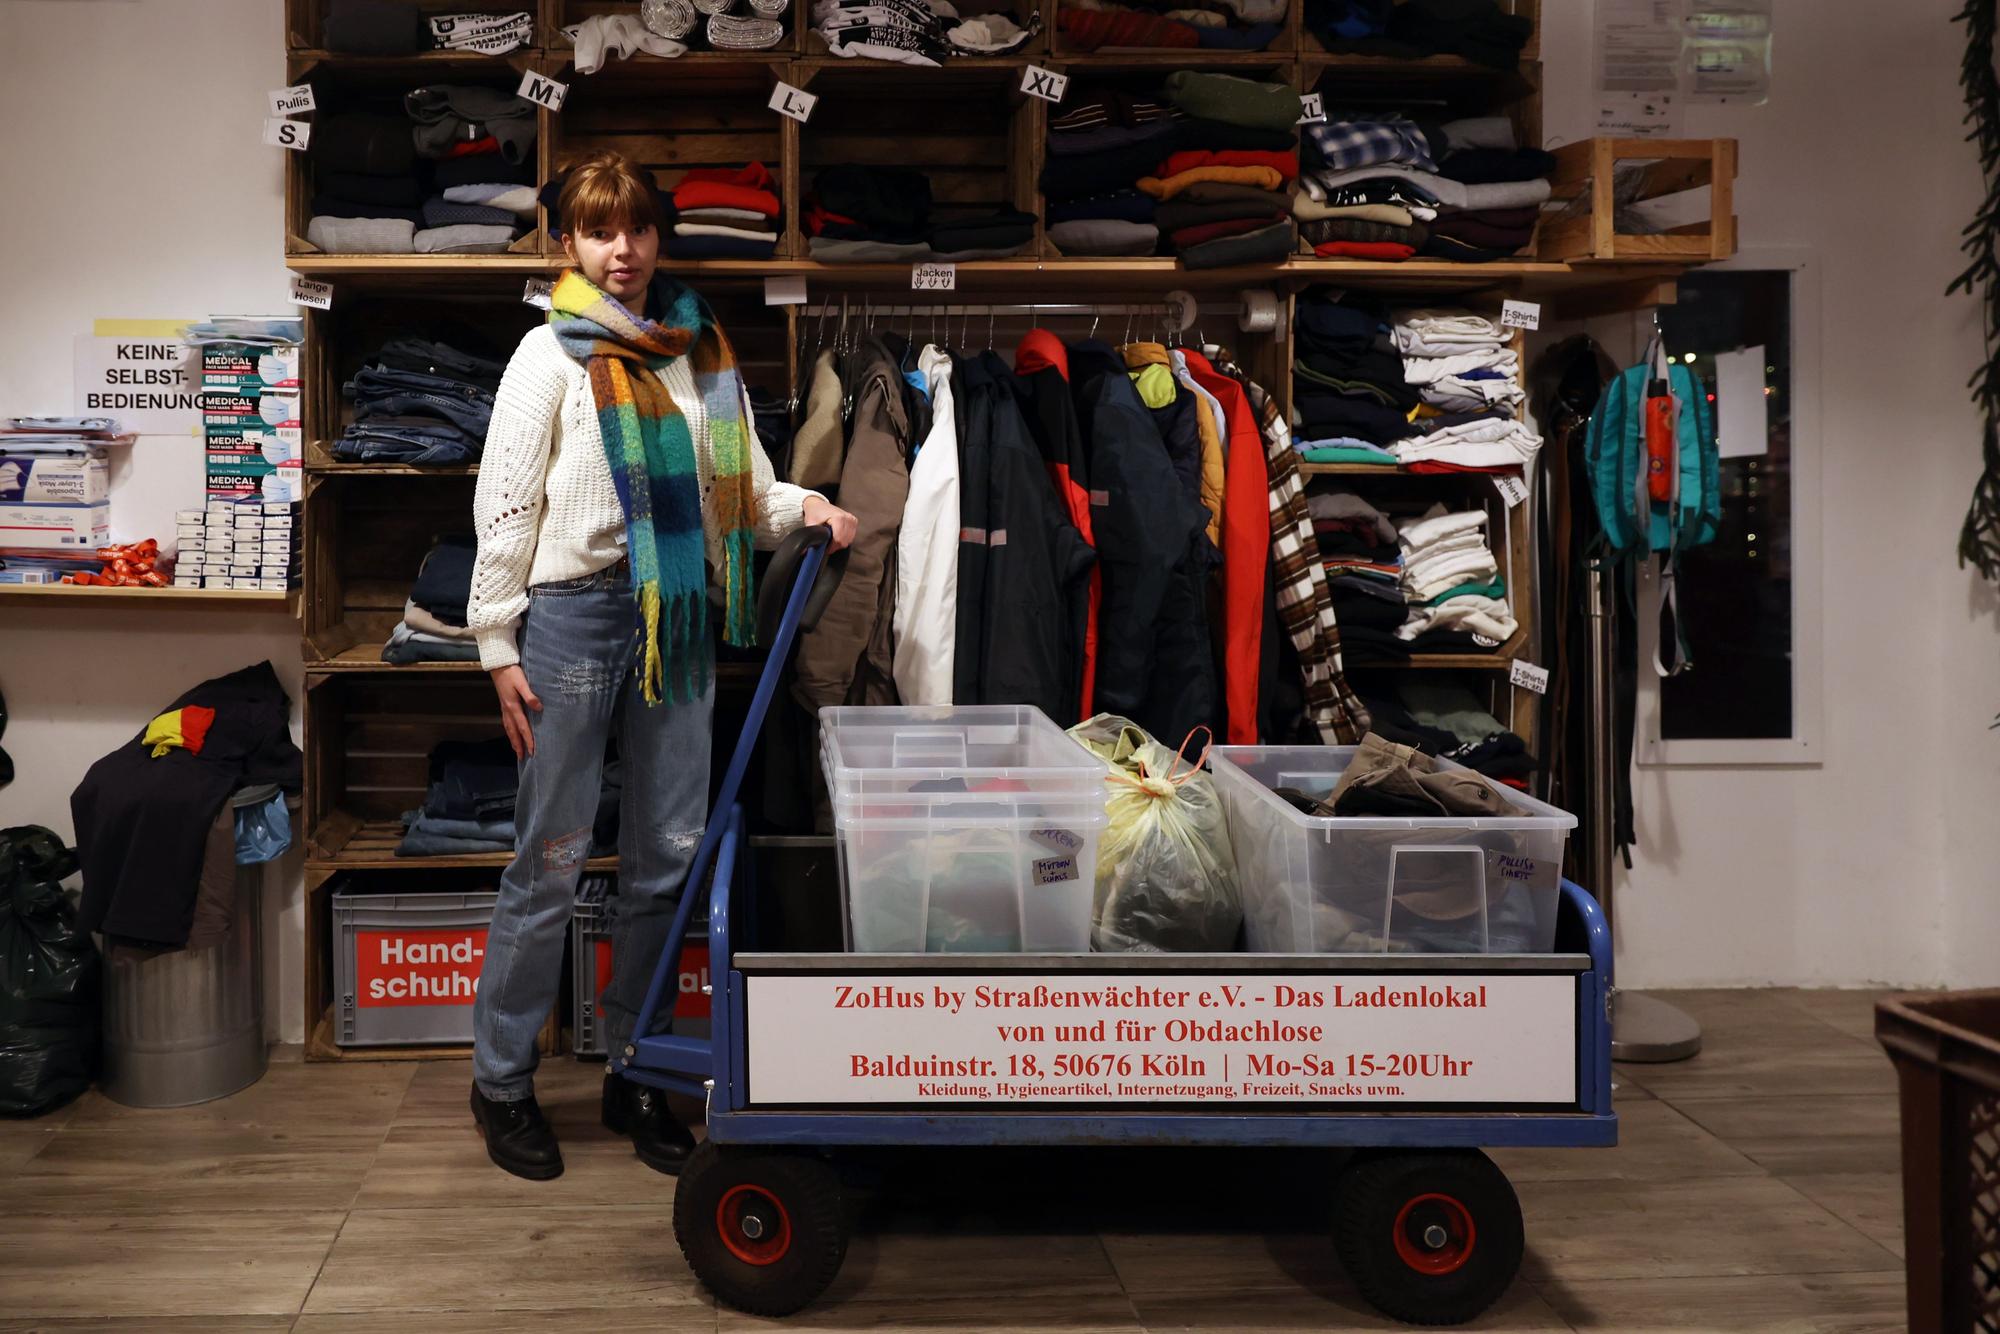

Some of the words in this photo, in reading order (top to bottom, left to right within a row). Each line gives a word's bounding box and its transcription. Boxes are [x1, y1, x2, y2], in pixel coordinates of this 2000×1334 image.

[528, 78, 555, 105] M
[1027, 71, 1059, 100] XL
[277, 97, 310, 111] Pullis
[782, 91, 796, 114] L
[279, 124, 296, 144] S
[917, 269, 953, 277] Jacken
[297, 278, 328, 293] Lange
[294, 291, 327, 305] Hosen
[1504, 309, 1538, 322] T-Shirts
[116, 344, 179, 361] KEINE
[205, 356, 252, 366] MEDICAL
[105, 368, 190, 385] SELBST-
[205, 397, 253, 406] MEDICAL
[209, 476, 255, 485] MEDICAL
[1515, 667, 1545, 686] T-Shirts
[380, 937, 484, 965] Hand-
[834, 985, 925, 1009] ZoHus
[934, 985, 966, 1014] by
[974, 985, 1190, 1009] Straßenwächter
[1198, 985, 1246, 1009] e.V.
[1273, 985, 1324, 1009] Das
[1334, 984, 1487, 1009] Ladenlokal
[997, 1025, 1045, 1042] von
[1054, 1019, 1106, 1043] und
[1115, 1019, 1156, 1042] für
[1164, 1019, 1323, 1043] Obdachlose
[850, 1054, 997, 1078] Balduinstr.
[1008, 1054, 1046, 1081] 18,
[1053, 1054, 1132, 1078] 50676
[1140, 1054, 1206, 1078] Köln
[1248, 1053, 1336, 1078] Mo-Sa
[1346, 1053, 1473, 1078] 15-20Uhr
[918, 1082, 992, 1098] Kleidung,
[996, 1082, 1113, 1098] Hygieneartikel,
[1117, 1082, 1238, 1098] Internetzugang,
[1242, 1082, 1305, 1097] Freizeit,
[1308, 1082, 1363, 1096] Snacks
[1367, 1086, 1406, 1096] uvm.
